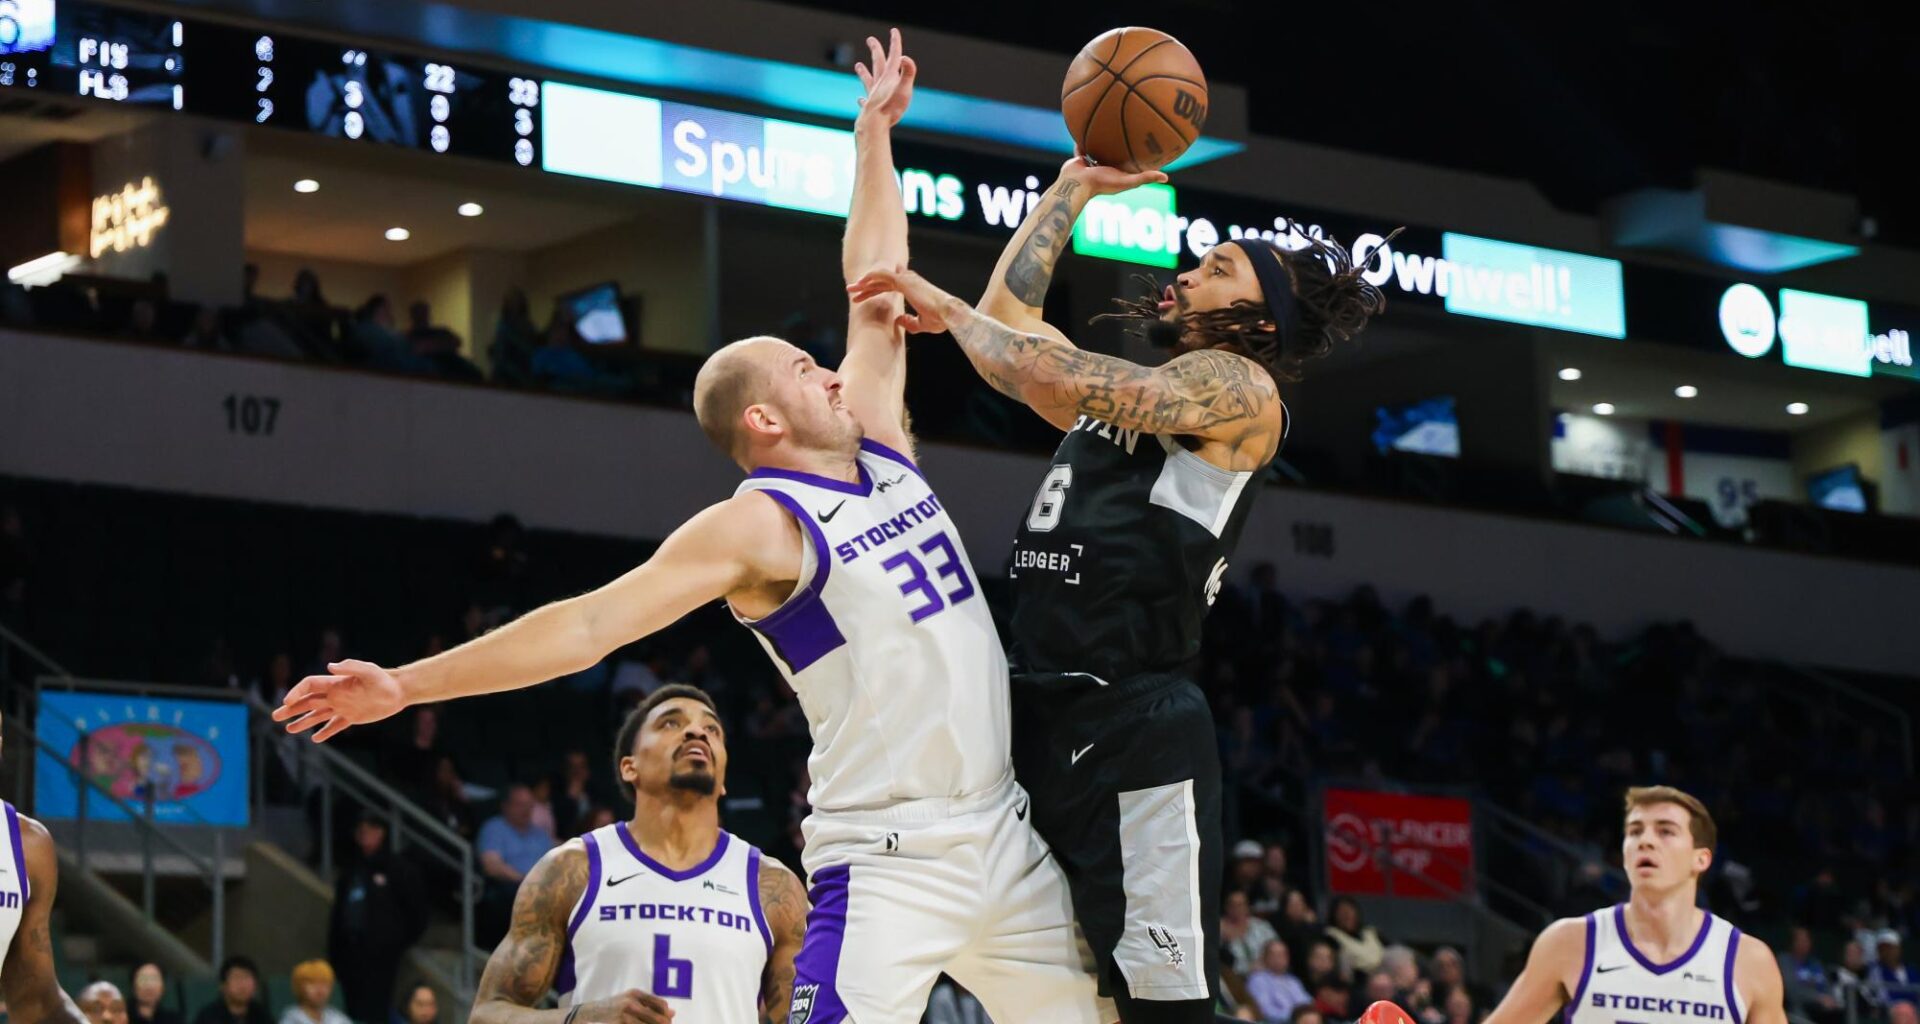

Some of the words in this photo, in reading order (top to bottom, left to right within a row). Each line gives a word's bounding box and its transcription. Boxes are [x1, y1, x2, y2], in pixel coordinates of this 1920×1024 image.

[976, 174, 1041, 229] wi
[1085, 198, 1220, 259] more
[1351, 232, 1572, 316] Ownwell!
[222, 394, 281, 436] 107
[1026, 463, 1073, 533] 6
[834, 493, 942, 565] STOCKTON
[879, 529, 975, 625] 33
[1014, 549, 1071, 573] LEDGER
[599, 903, 752, 933] STOCKTON
[1591, 992, 1726, 1021] STOCKTON
